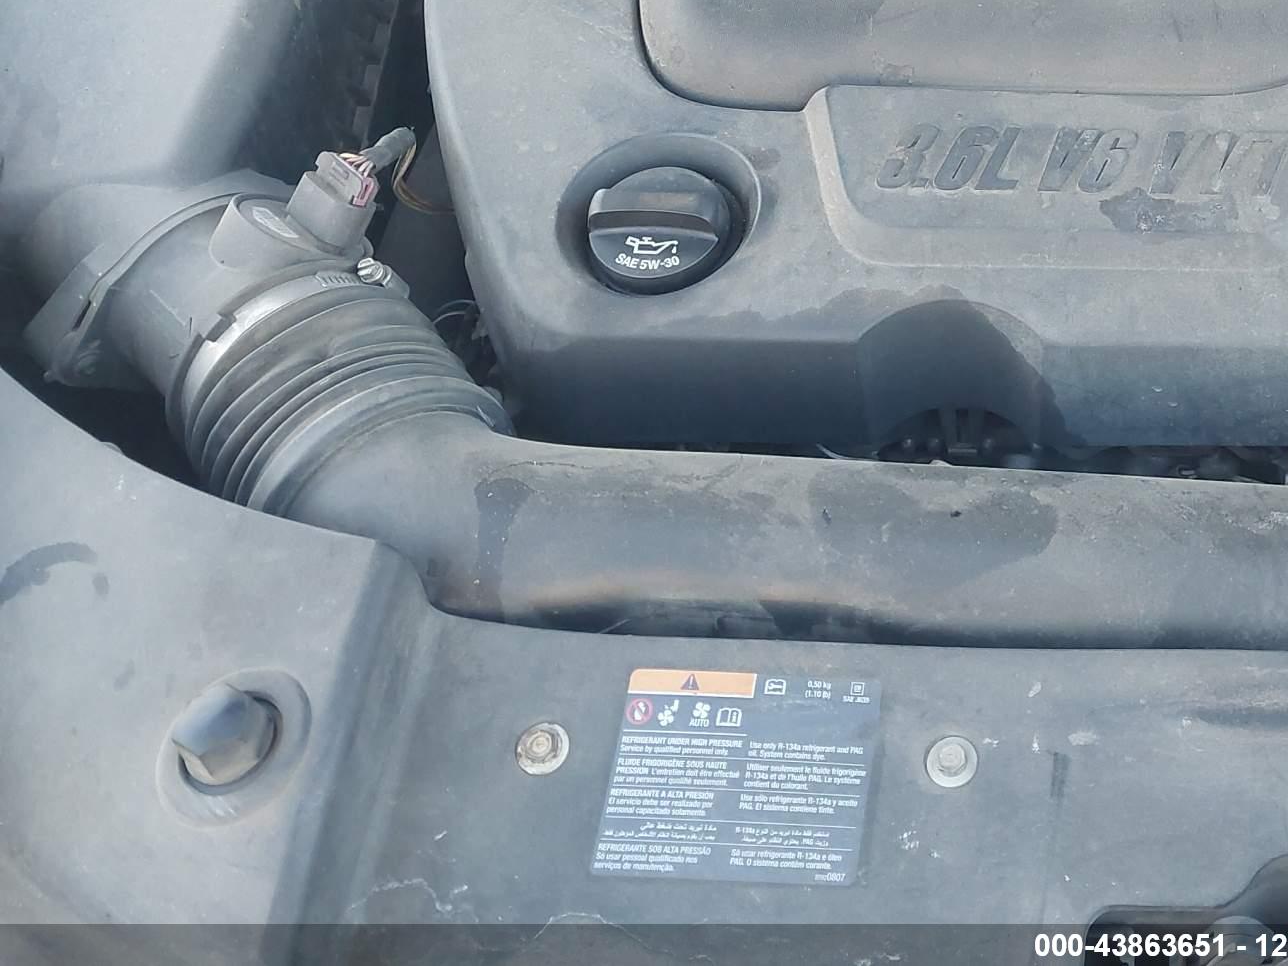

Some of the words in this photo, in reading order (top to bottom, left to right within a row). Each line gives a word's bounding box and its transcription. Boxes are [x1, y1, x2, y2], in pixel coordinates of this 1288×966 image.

[875, 123, 1023, 194] 3.6L
[1037, 127, 1138, 195] V6
[615, 253, 637, 270] SAE
[640, 255, 680, 270] 5W-30
[805, 690, 822, 699] (1.10
[689, 719, 709, 727] AUTO
[622, 736, 666, 745] REFRIGERANT
[667, 738, 689, 746] UNDER
[709, 739, 743, 748] PRESSURE
[654, 746, 681, 754] qualified
[682, 747, 713, 755] personnel
[763, 742, 776, 751] only
[778, 743, 800, 751] R-134a
[802, 744, 835, 754] refrigerant
[850, 746, 863, 754] PAG
[760, 751, 782, 759] System
[784, 751, 811, 759] contains
[618, 758, 640, 766] FLUIDE
[686, 760, 704, 768] SOUS
[705, 761, 727, 769] HAUTE
[747, 763, 769, 771] Utiliser
[771, 764, 803, 773] seulement
[813, 766, 830, 774] fluide
[635, 777, 667, 785] personnel
[746, 772, 768, 780] R-134a
[611, 788, 659, 797] REFRIGERANTE
[667, 790, 684, 798] ALTA
[616, 797, 641, 805] servicio
[642, 798, 658, 806] debe
[671, 799, 700, 807] realizado
[702, 801, 712, 809] por
[769, 796, 806, 805] refrigerante
[808, 797, 831, 805] R-134a
[607, 806, 634, 814] personal
[636, 807, 670, 815] capacitado
[790, 805, 817, 813] contiene
[598, 843, 647, 852] REFRIGERANTE
[648, 845, 662, 853] SOB
[622, 853, 647, 862] pessoal
[648, 854, 684, 864] qualificado
[757, 850, 795, 860] refrigerante
[753, 859, 778, 867] sistema
